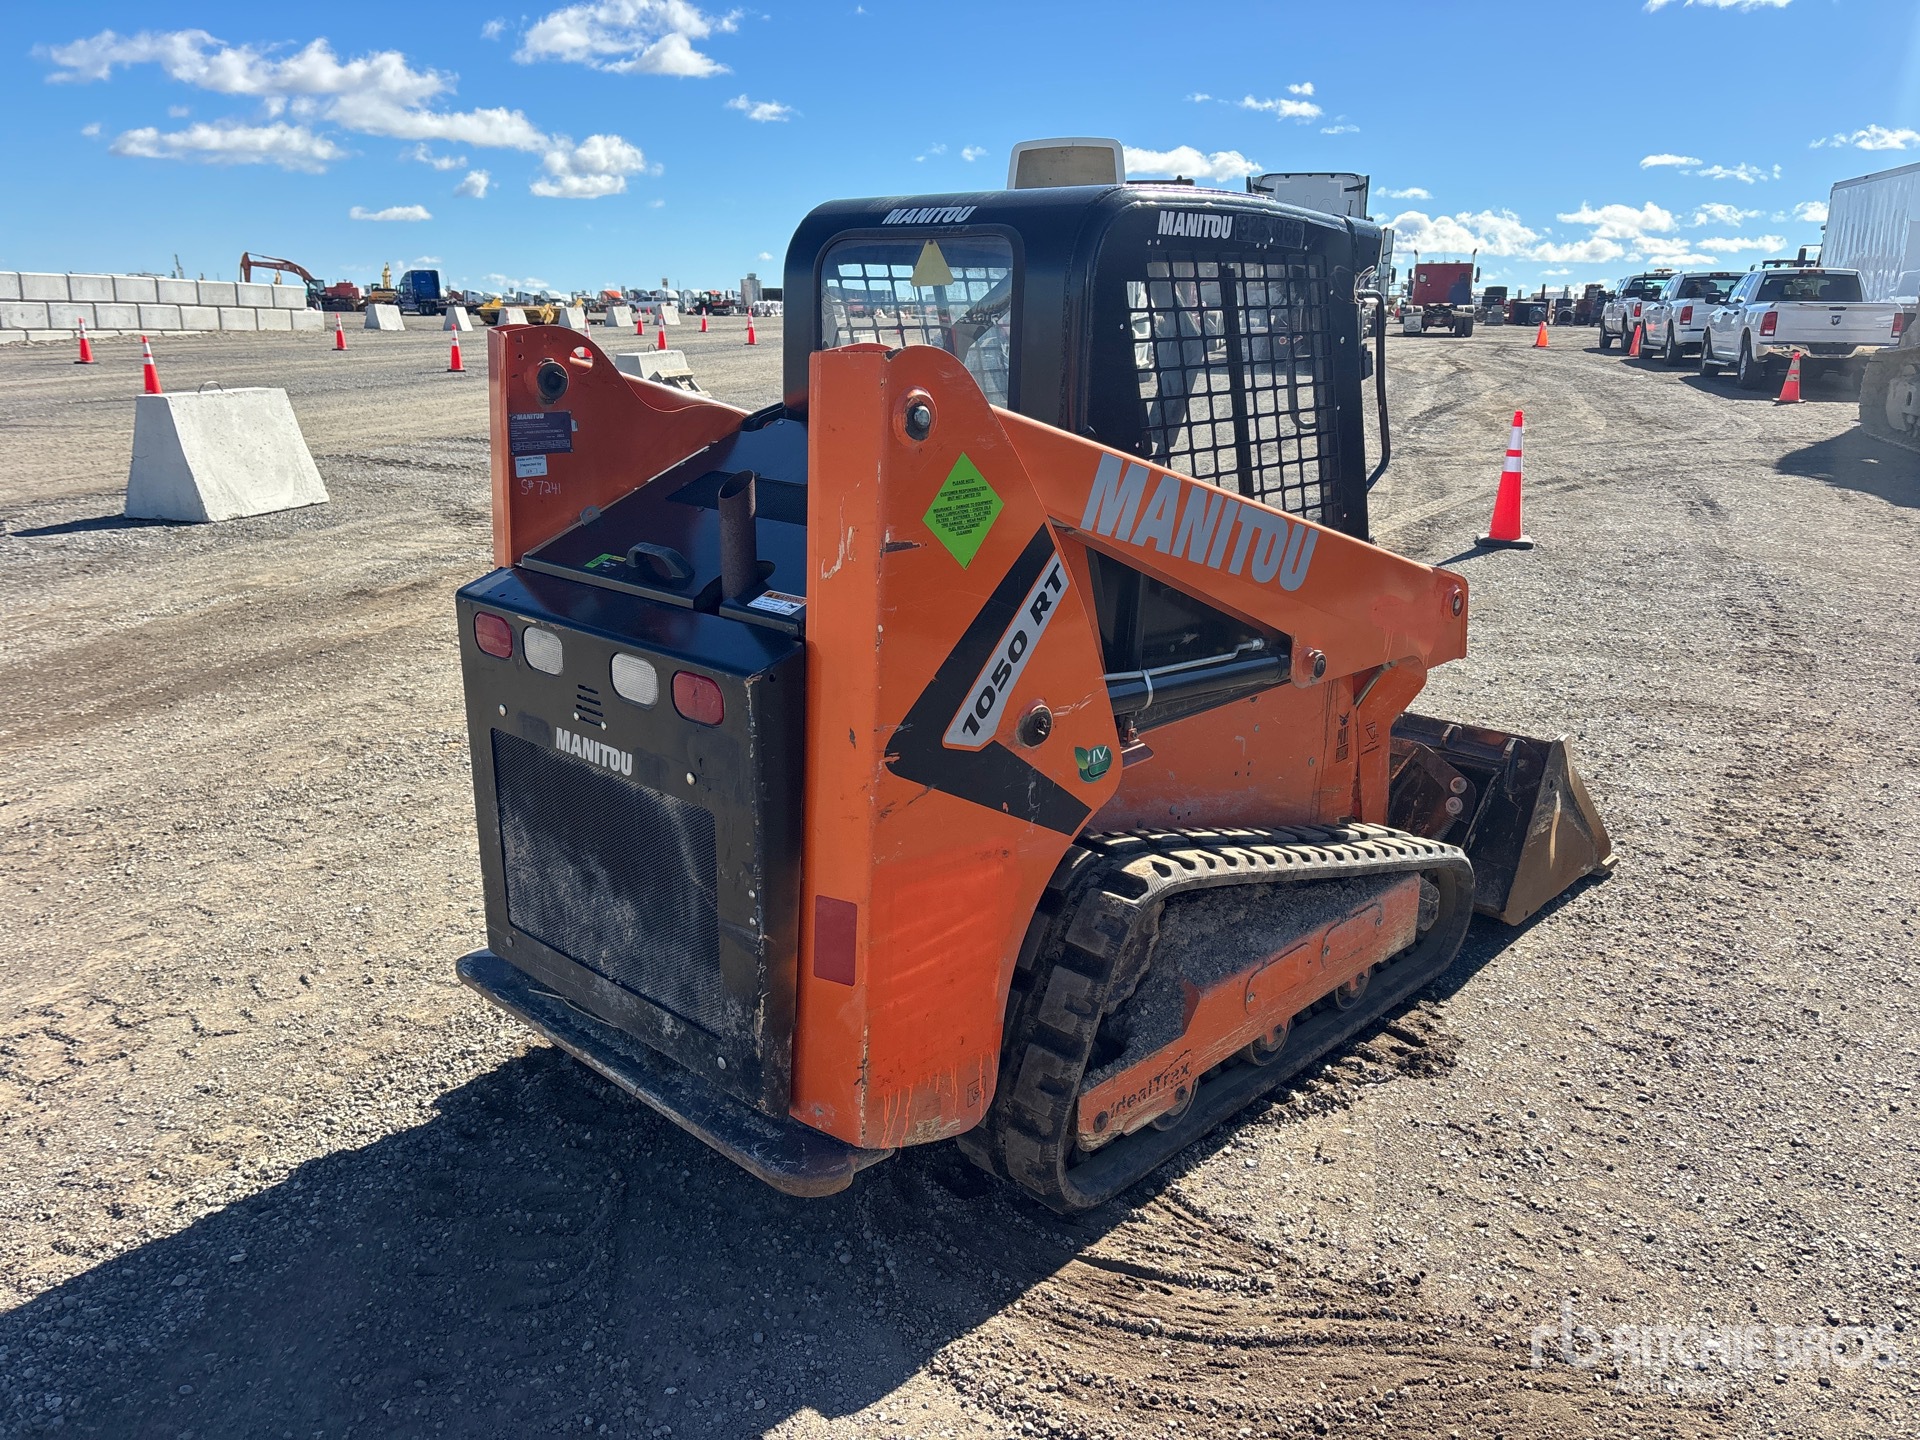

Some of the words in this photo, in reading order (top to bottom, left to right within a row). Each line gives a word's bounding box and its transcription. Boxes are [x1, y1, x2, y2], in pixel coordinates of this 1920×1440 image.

[881, 205, 978, 225] MANITOU
[1157, 210, 1233, 239] MANITOU
[536, 480, 562, 495] 7241
[1080, 452, 1319, 592] MANITOU
[962, 629, 1028, 737] 1050
[1030, 563, 1062, 626] RT
[556, 727, 633, 776] MANITOU
[1092, 745, 1108, 763] IV
